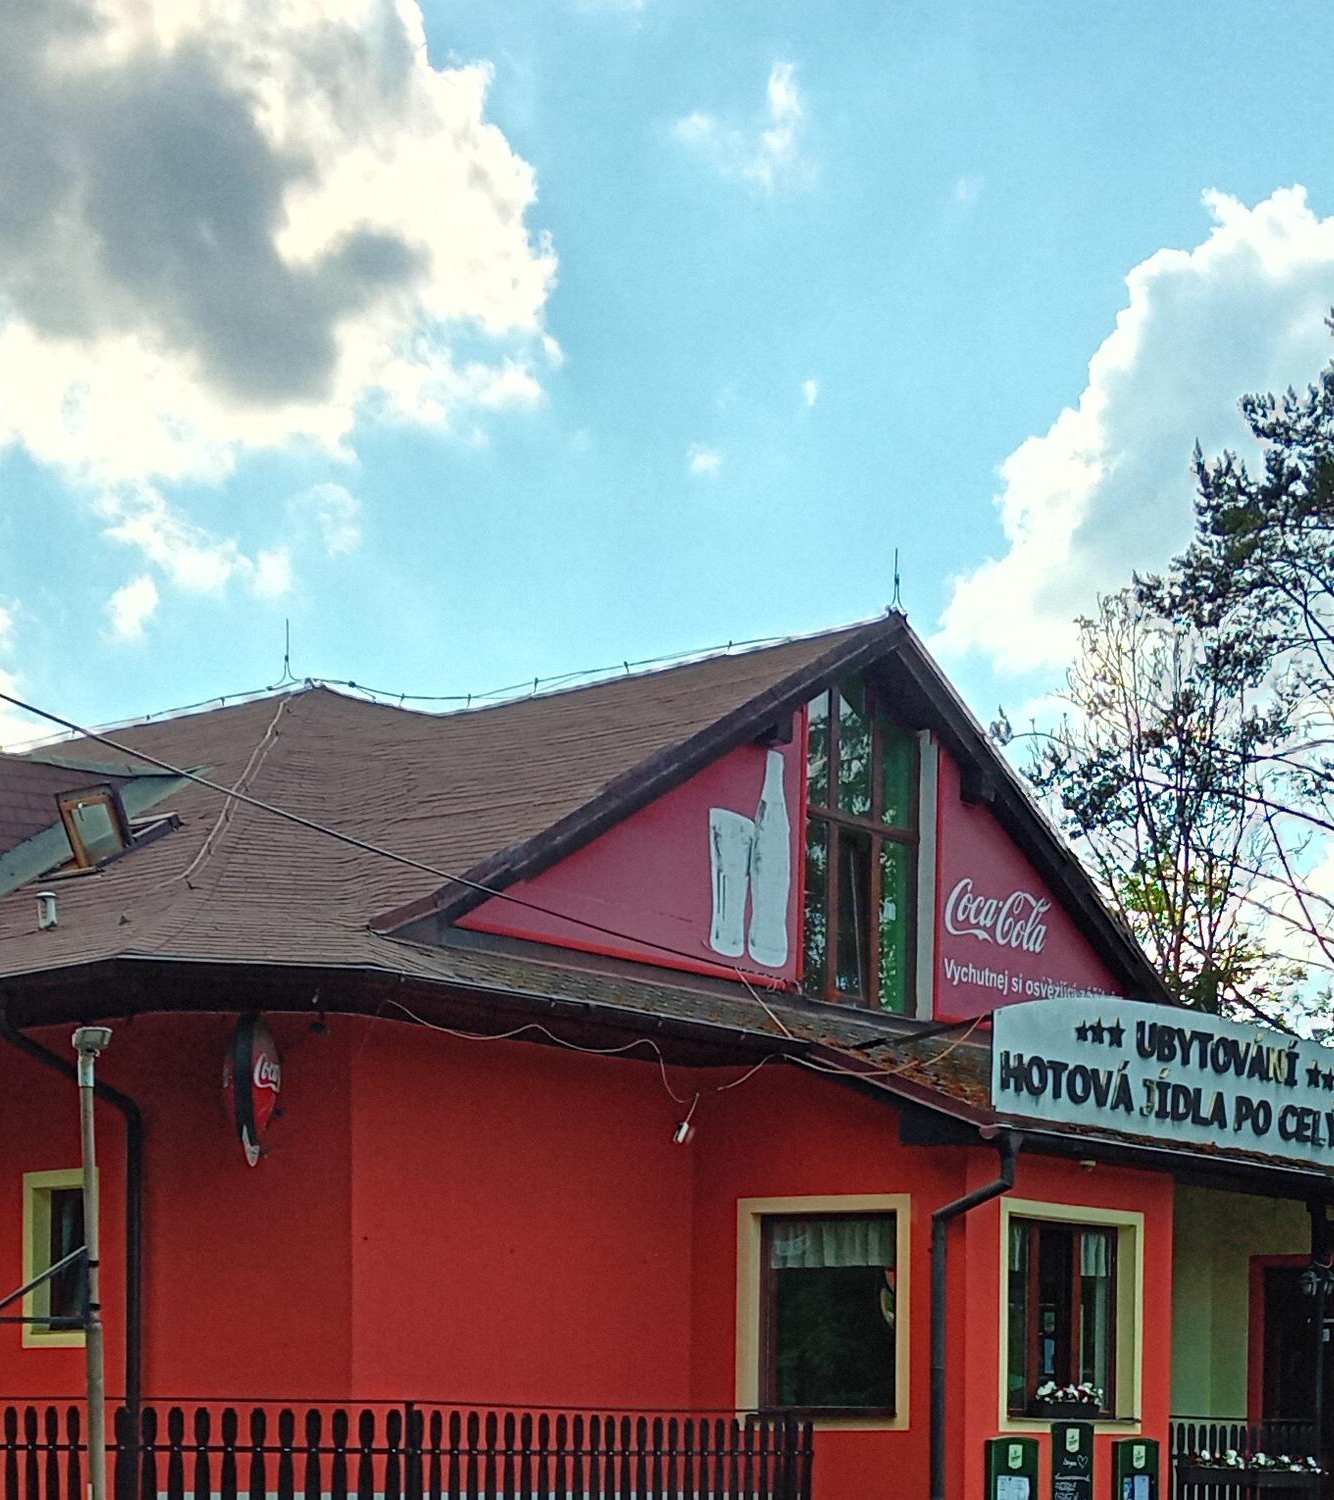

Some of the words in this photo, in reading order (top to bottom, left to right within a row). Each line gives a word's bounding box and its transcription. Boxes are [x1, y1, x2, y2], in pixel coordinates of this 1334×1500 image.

[945, 878, 1051, 953] Coca-Cola
[944, 958, 1009, 995] Vychutnej
[1011, 973, 1023, 993] si
[1136, 1020, 1300, 1087] UBYTOVÁNÍ
[1000, 1050, 1134, 1114] HOTOVÁ
[1139, 1067, 1227, 1130] JÍDLA
[1234, 1096, 1273, 1136] PO
